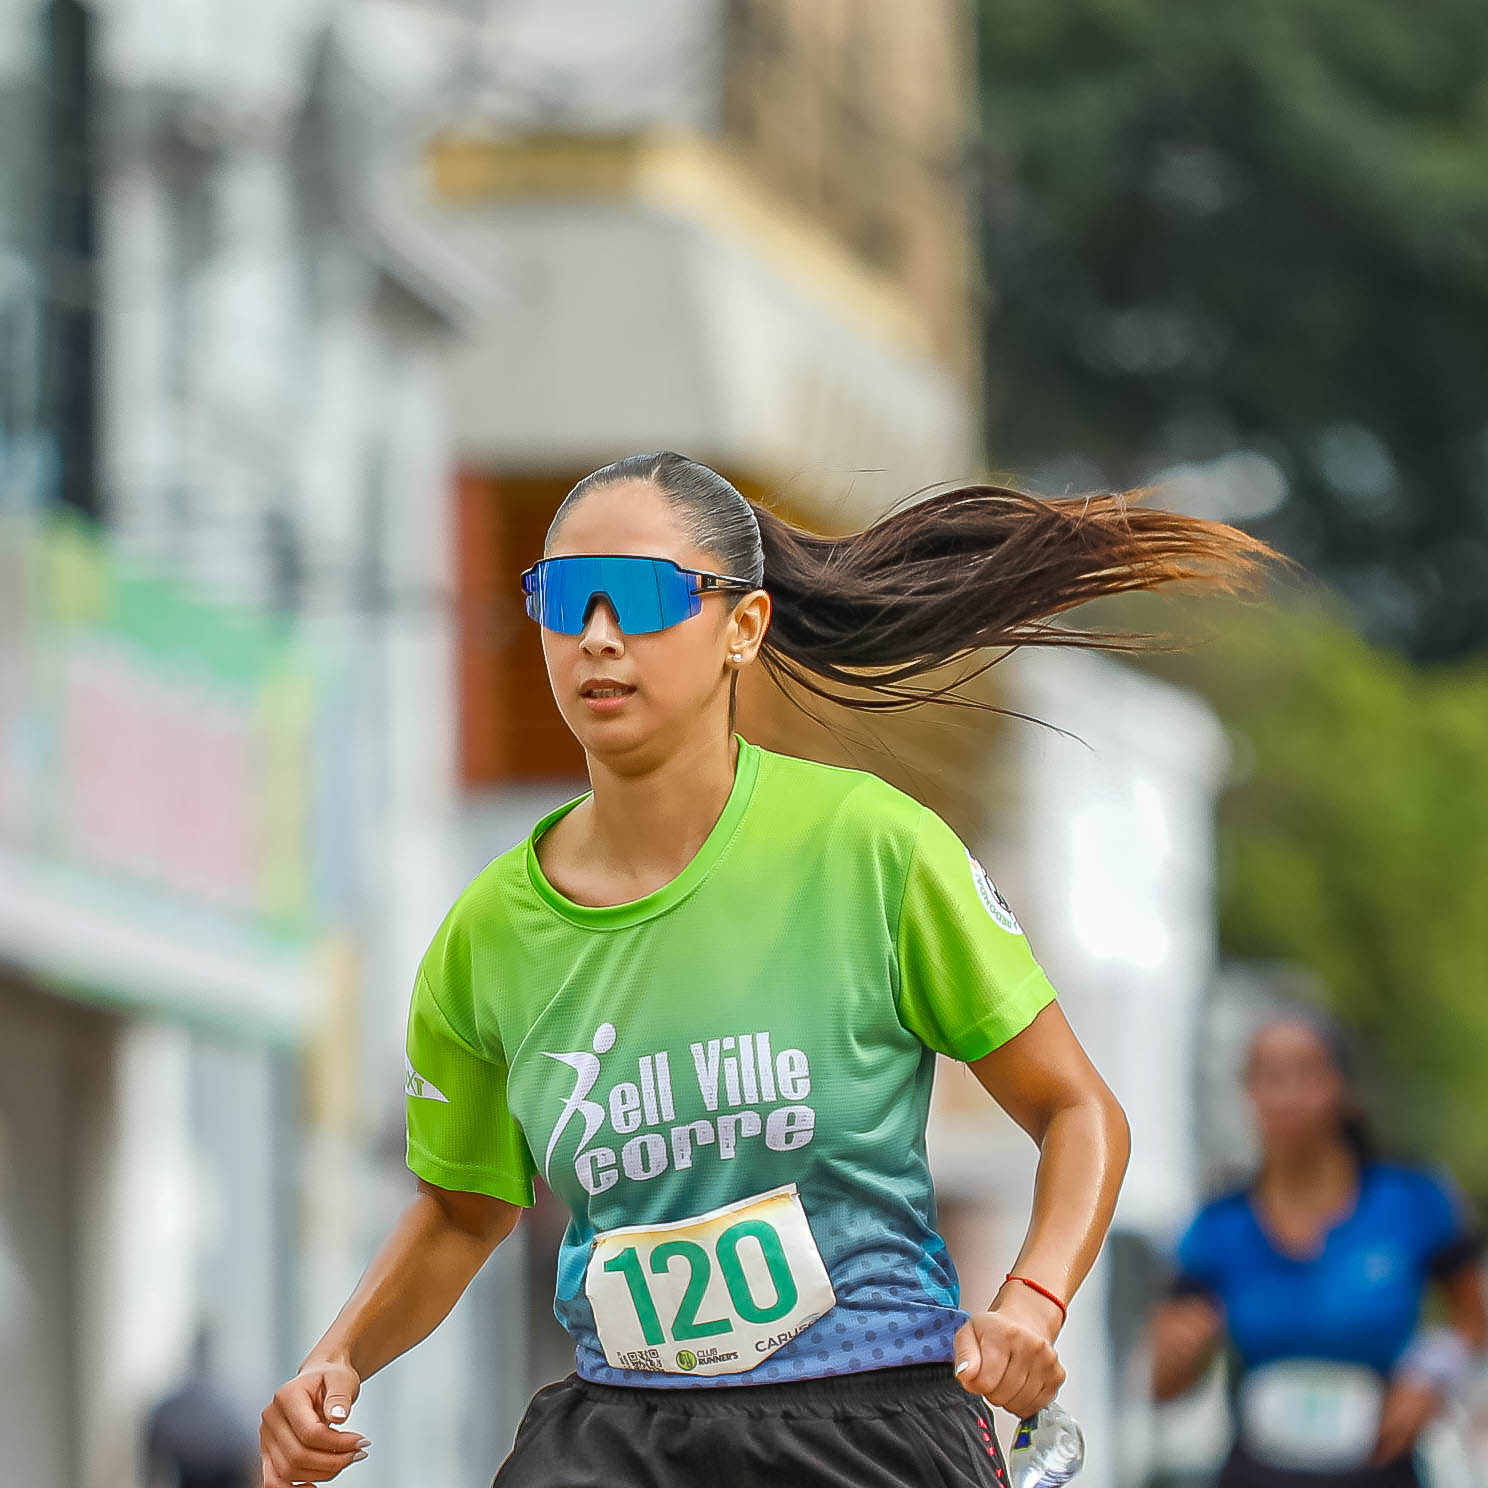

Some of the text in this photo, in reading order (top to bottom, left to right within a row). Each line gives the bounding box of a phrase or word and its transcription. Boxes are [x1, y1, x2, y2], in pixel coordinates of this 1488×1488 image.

[689, 1031, 811, 1112] Ville
[574, 1104, 816, 1196] corre
[603, 1219, 799, 1347] 120
